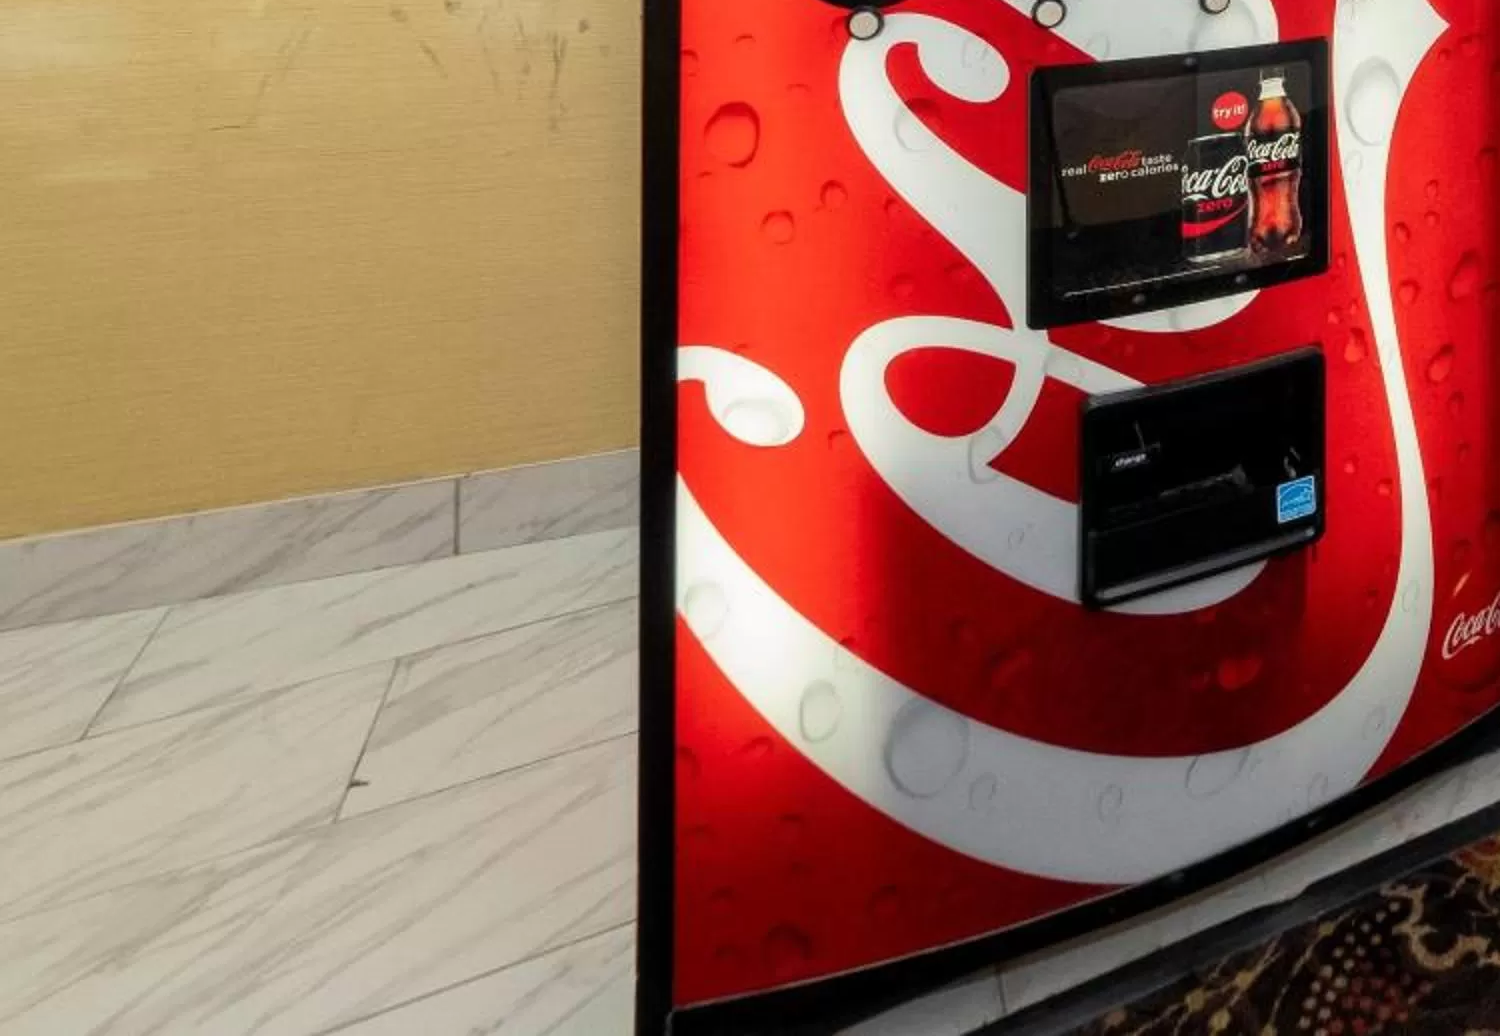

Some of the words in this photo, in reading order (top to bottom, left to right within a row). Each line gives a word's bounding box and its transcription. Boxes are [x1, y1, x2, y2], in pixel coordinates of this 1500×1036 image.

[1212, 108, 1232, 120] try
[1232, 103, 1246, 116] it!
[1061, 163, 1087, 177] real
[1141, 153, 1173, 167] taste
[1099, 169, 1129, 183] zero
[1130, 162, 1179, 178] calories
